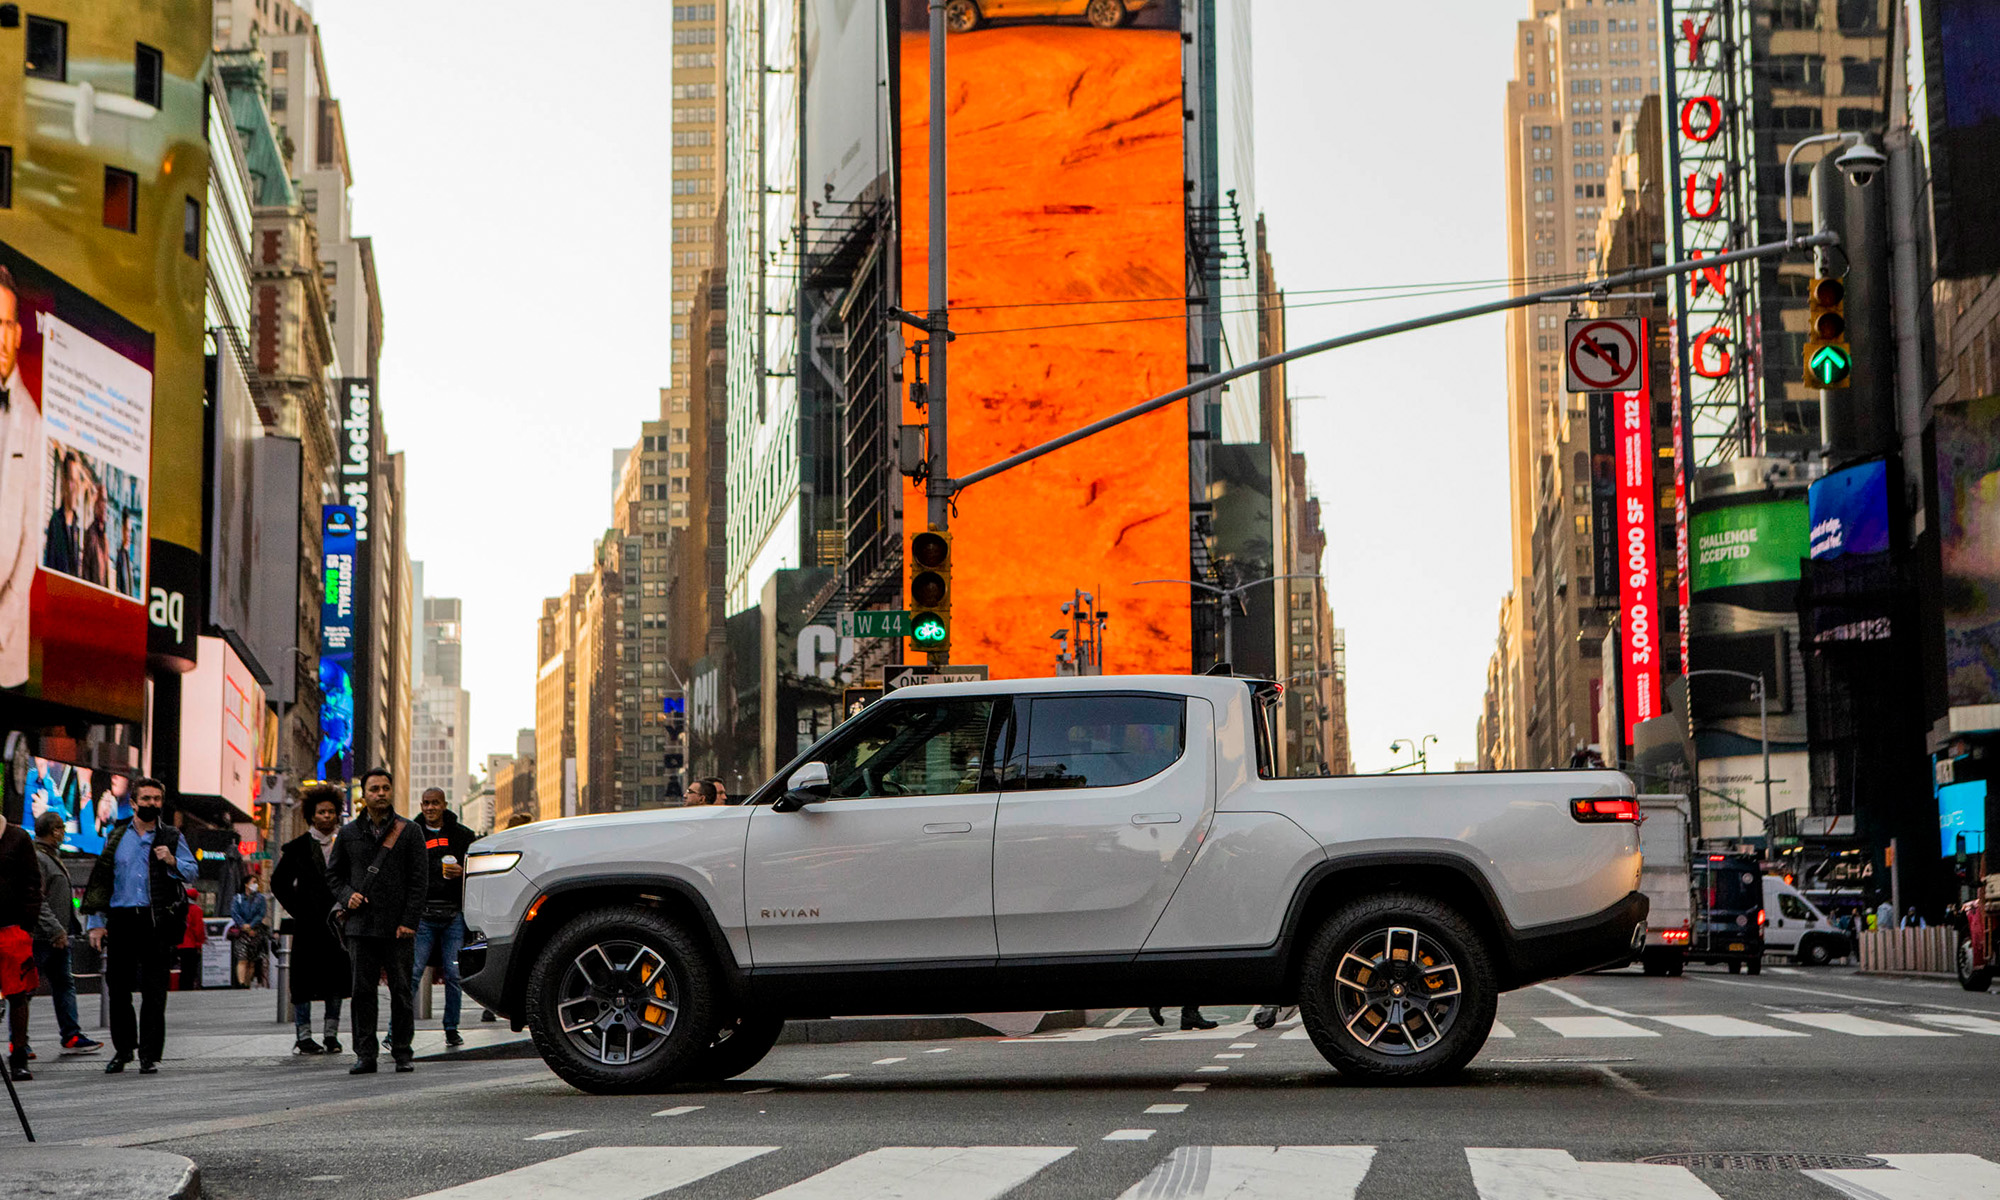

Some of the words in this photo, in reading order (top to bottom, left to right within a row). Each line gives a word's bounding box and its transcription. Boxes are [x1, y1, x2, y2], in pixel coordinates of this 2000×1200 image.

[1681, 12, 1732, 378] YOUNG
[1624, 399, 1640, 430] 212
[343, 384, 369, 475] Locker
[1627, 497, 1645, 524] SF
[1699, 528, 1758, 549] CHALLENGE
[326, 554, 339, 569] IS
[1628, 526, 1649, 588] 9,000
[1700, 544, 1750, 564] ACCEPTED
[325, 569, 339, 604] BACK
[338, 554, 352, 618] FOOTBALL
[858, 615, 872, 634] W
[881, 614, 902, 634] 44
[1631, 604, 1652, 665] 3,000
[900, 676, 929, 687] ONE
[761, 908, 820, 919] RIVIAN
